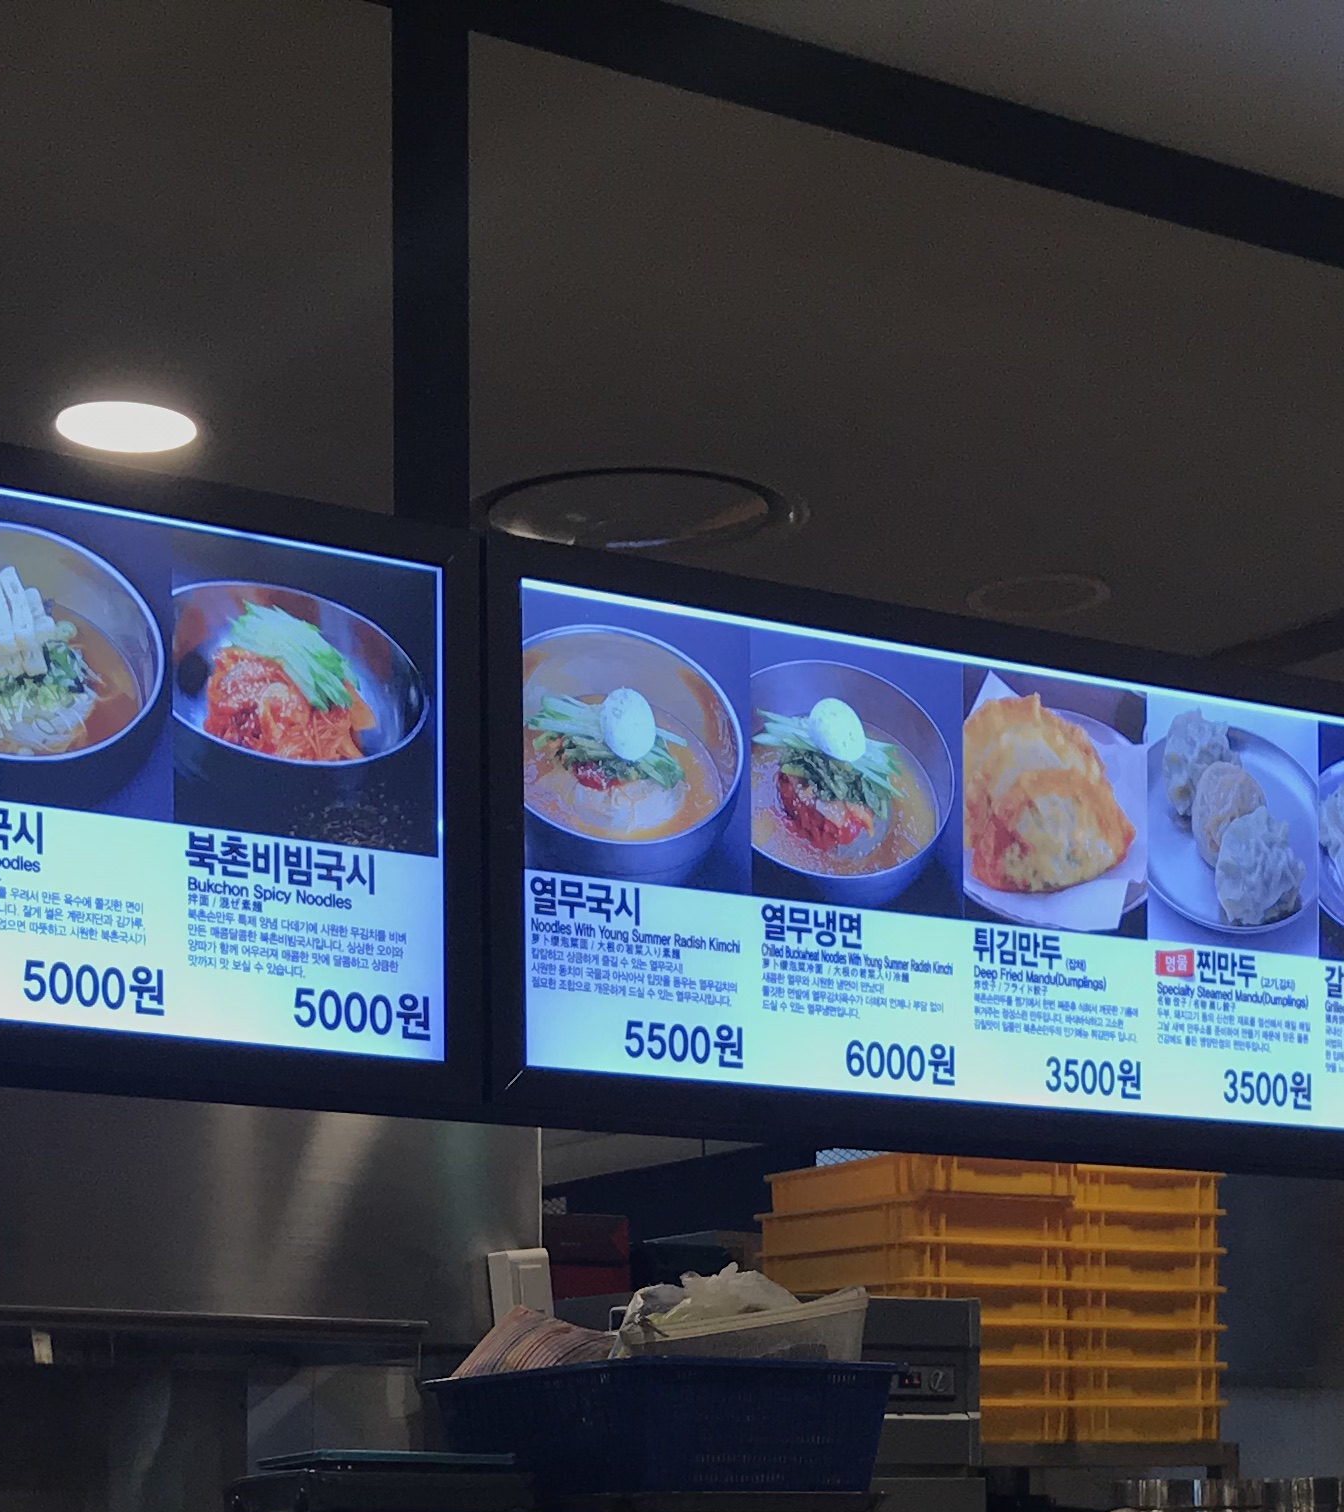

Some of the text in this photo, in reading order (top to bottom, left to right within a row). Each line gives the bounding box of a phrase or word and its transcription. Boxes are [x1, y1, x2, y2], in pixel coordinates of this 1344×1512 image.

[185, 831, 375, 896] 북촌비빔국시
[42, 892, 61, 905] 만든
[64, 893, 91, 908] 육수에
[188, 876, 352, 910] Bukchon Spicy Noodles
[530, 876, 640, 926] 열무국시
[188, 908, 235, 925] 북촌손만두
[238, 913, 256, 927] 특제
[260, 916, 278, 930] 양념
[321, 923, 348, 937] 시원한
[531, 917, 740, 953] Noodles With Young Summer Radish Kimchi
[761, 903, 862, 950] 열무냉면
[761, 942, 783, 959] Chilled
[821, 950, 846, 964] Noodles
[848, 952, 862, 966] With
[864, 954, 882, 969] Young
[884, 955, 909, 970] Summer
[973, 928, 1062, 970] 튀김만두
[1197, 950, 1257, 988] 찐만두
[23, 959, 165, 1016] 5000원
[974, 965, 1107, 992] Deep Fried Mandu(Dumplings)
[1157, 981, 1195, 998] Specialty
[1197, 985, 1233, 1001] Steamed
[294, 986, 431, 1041] 5000원
[624, 1020, 743, 1069] 5500원
[846, 1040, 955, 1086] 6000원
[1046, 1056, 1141, 1100] 3500원
[1224, 1069, 1312, 1111] 3500원
